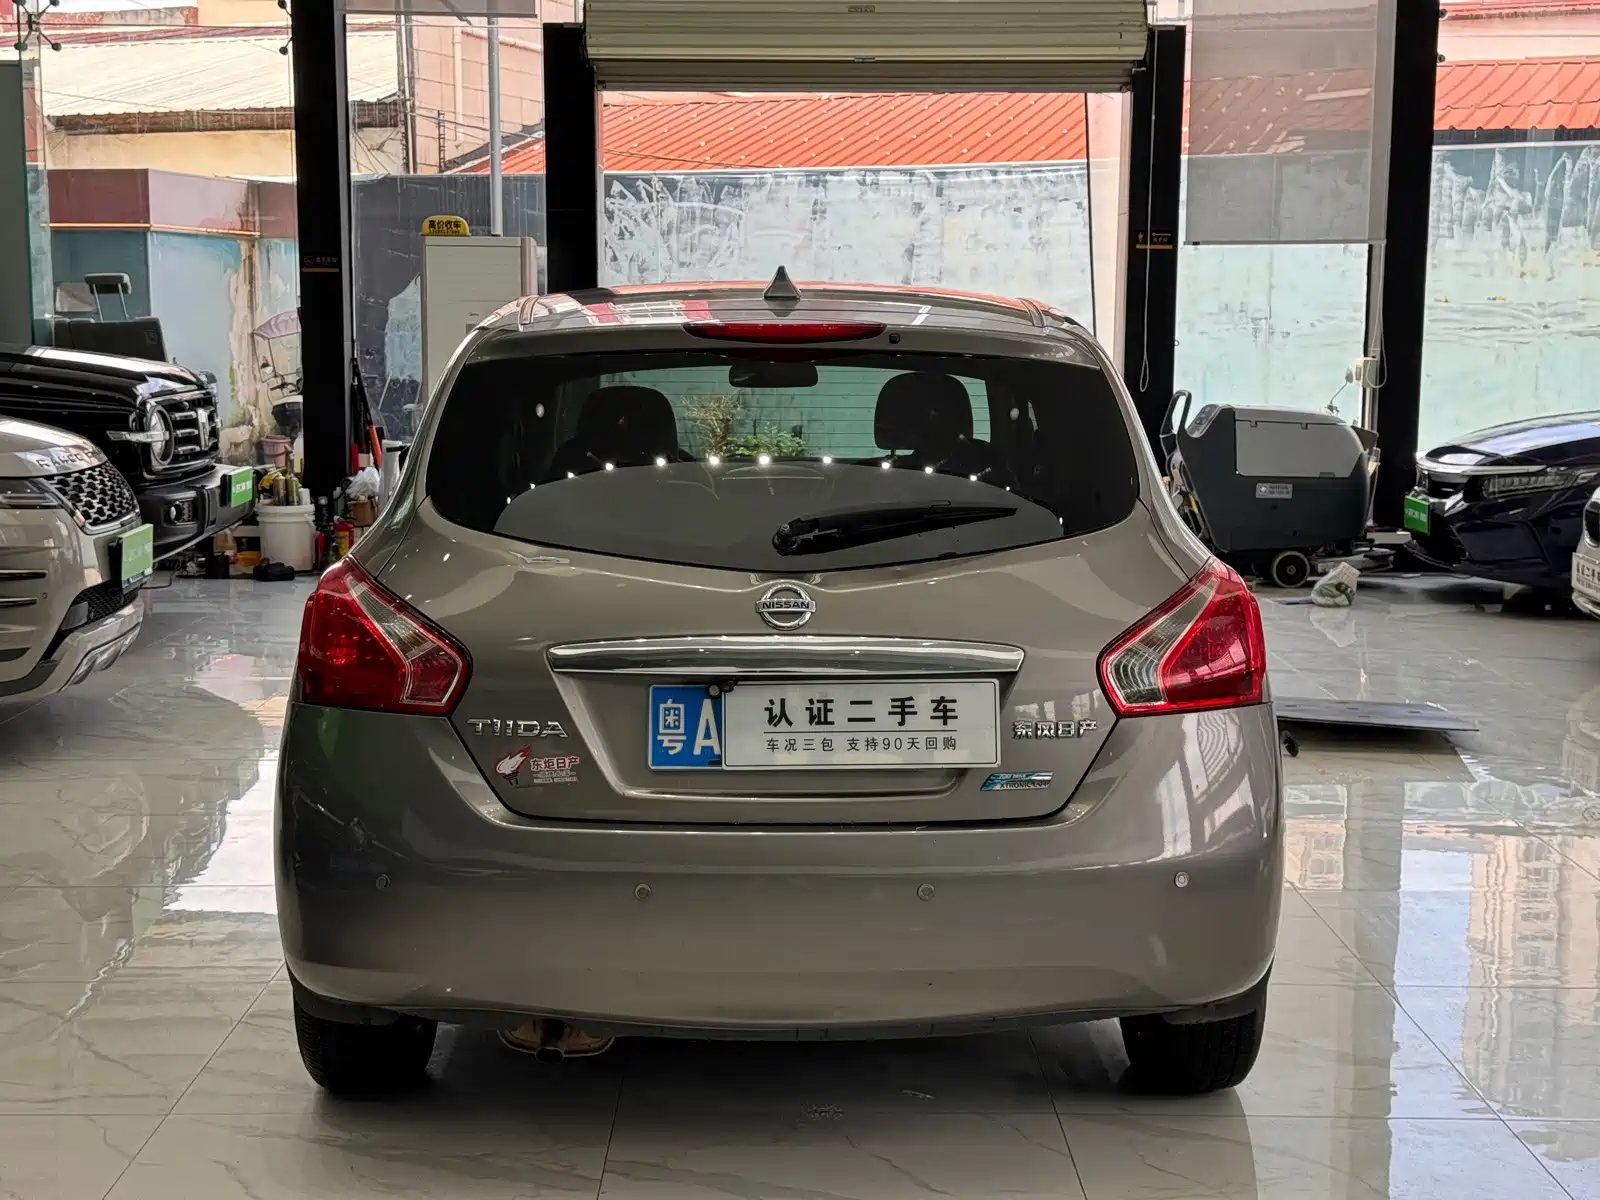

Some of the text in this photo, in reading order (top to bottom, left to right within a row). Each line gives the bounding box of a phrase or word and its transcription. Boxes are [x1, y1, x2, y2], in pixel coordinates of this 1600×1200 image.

[427, 219, 462, 230] 高价收车
[762, 601, 810, 609] NISSAN
[763, 695, 959, 728] 认证二手车
[466, 718, 569, 738] TIIDA
[656, 698, 722, 756] 粤A
[1012, 719, 1098, 739] 东风日产
[765, 735, 957, 753] 车况三包 支持90天回购
[530, 756, 580, 772] 东炬日产
